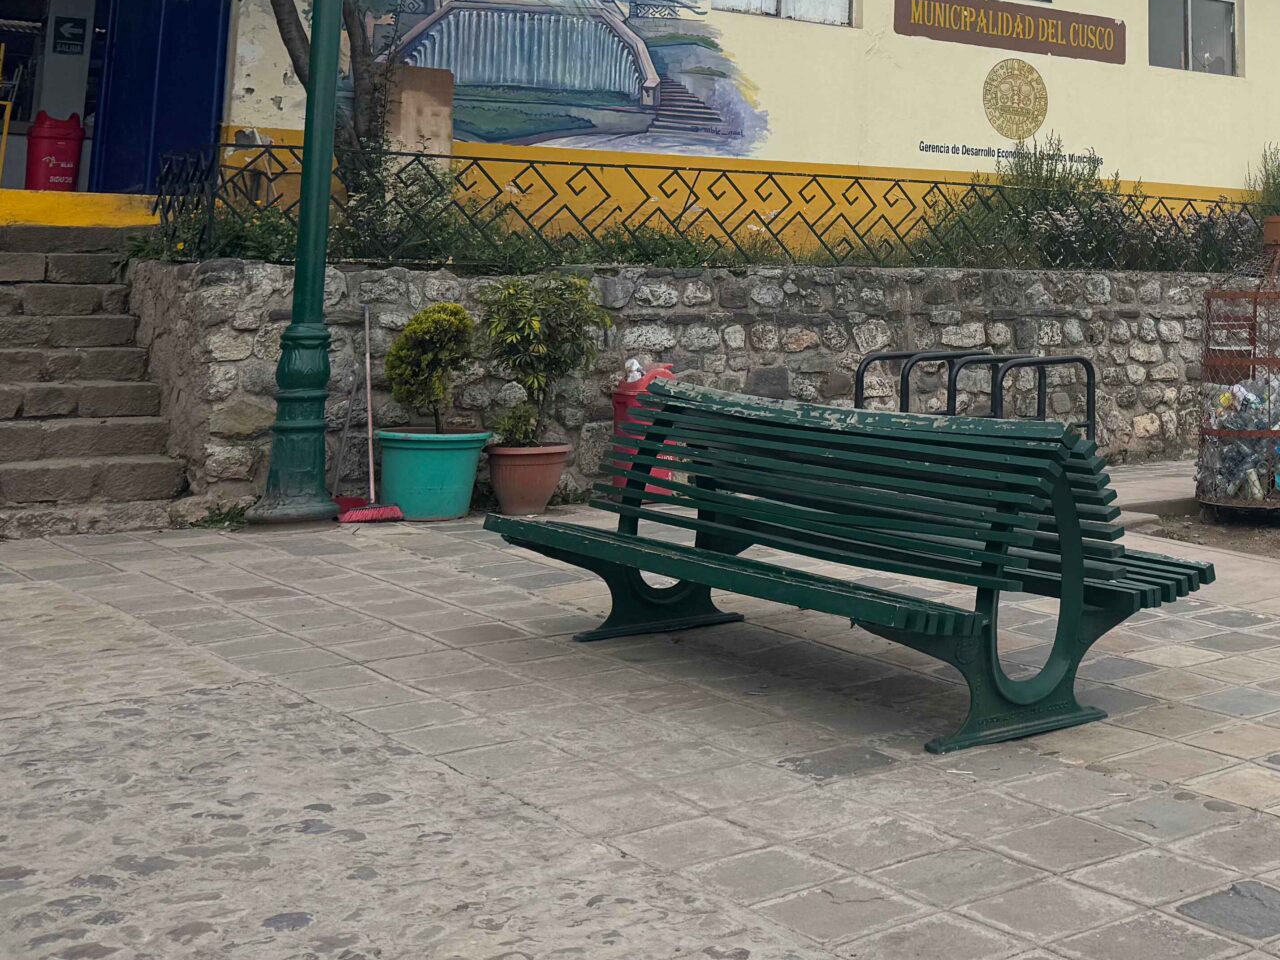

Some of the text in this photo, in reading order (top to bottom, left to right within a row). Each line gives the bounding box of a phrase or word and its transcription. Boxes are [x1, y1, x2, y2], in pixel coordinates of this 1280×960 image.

[1039, 17, 1066, 45] DEL
[1069, 22, 1114, 51] CUSCO
[919, 140, 949, 154] Gerencia
[951, 144, 960, 155] de
[962, 145, 995, 158] Desarrollo
